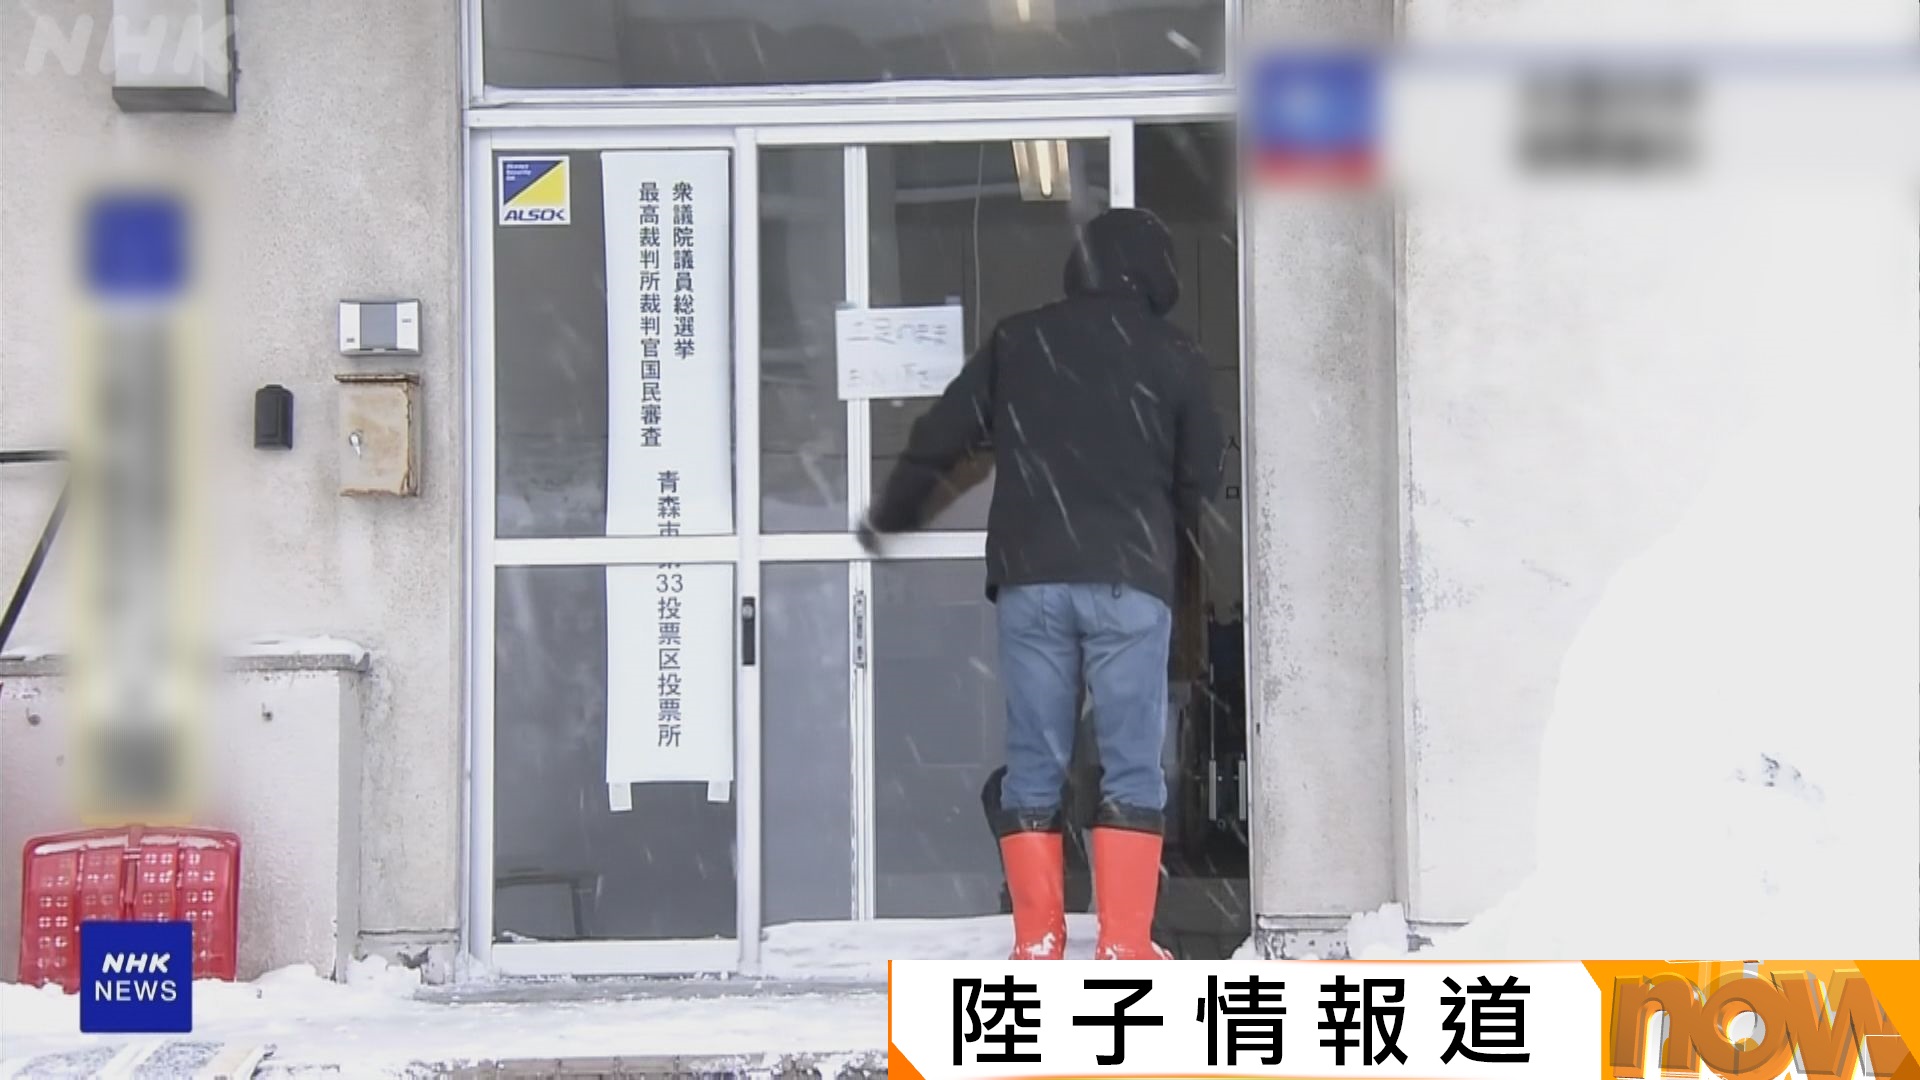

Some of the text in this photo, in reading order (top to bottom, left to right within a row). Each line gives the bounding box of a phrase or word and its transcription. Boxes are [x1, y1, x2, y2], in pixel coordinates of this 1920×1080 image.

[504, 208, 566, 221] ALSOK
[639, 181, 662, 447] 最高裁判所裁判官国民審査
[672, 181, 695, 360] 衆議院議員総選挙
[656, 470, 683, 747] 青森市33投票区投票所
